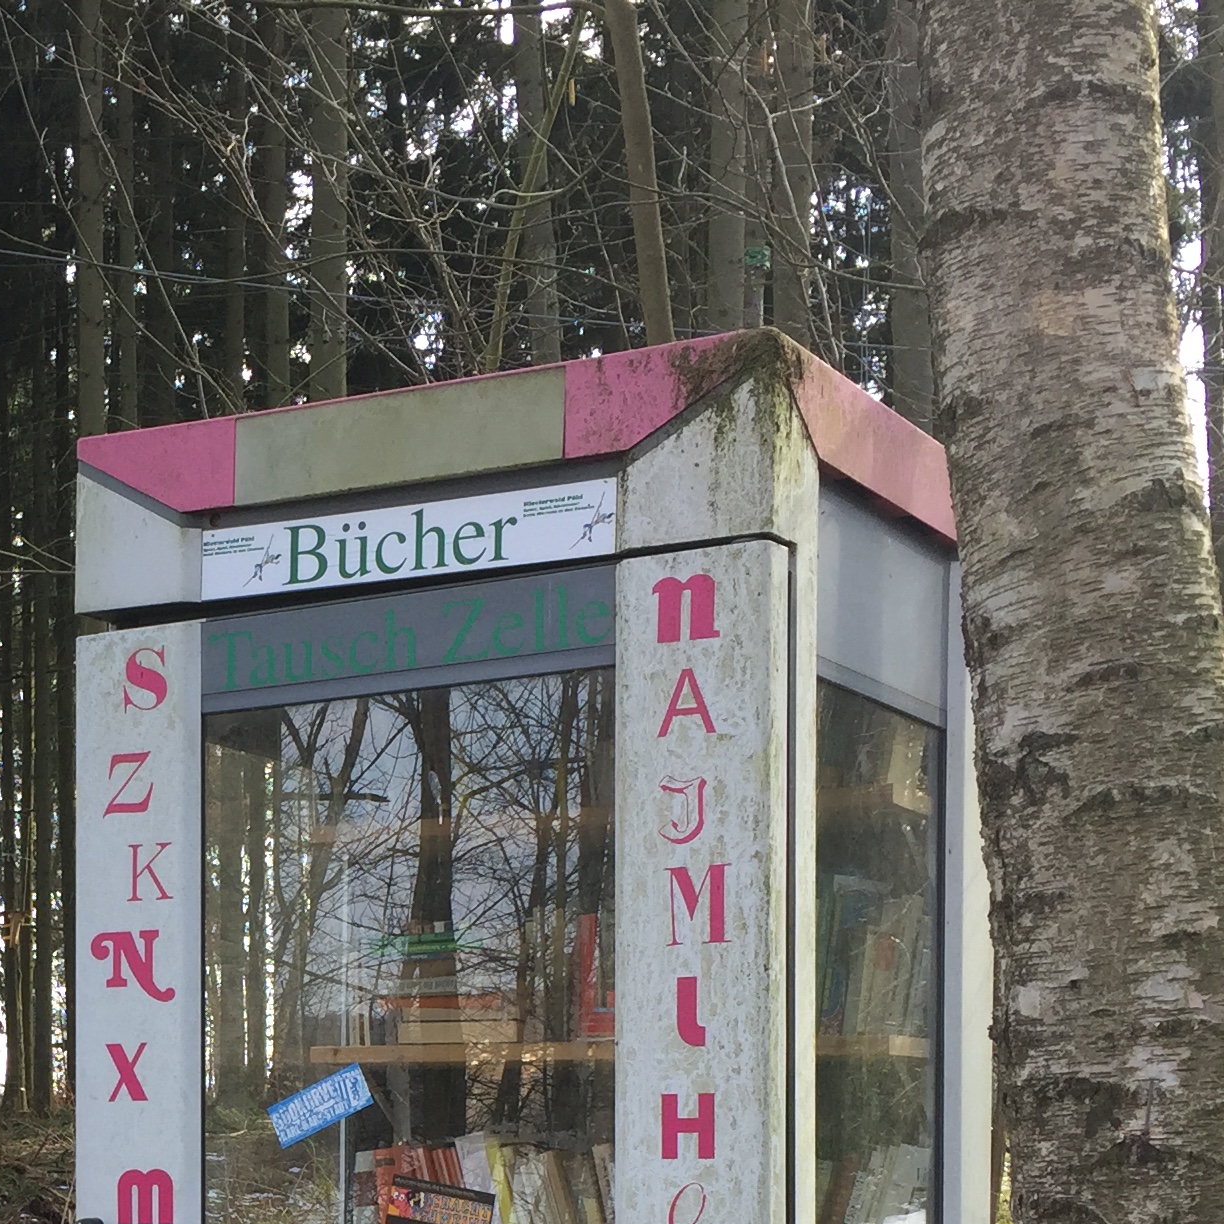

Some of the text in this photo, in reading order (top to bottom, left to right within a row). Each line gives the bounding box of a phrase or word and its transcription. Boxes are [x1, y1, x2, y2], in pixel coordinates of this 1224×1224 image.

[282, 508, 518, 586] Bücher
[208, 586, 613, 691] Tausch Zelle
